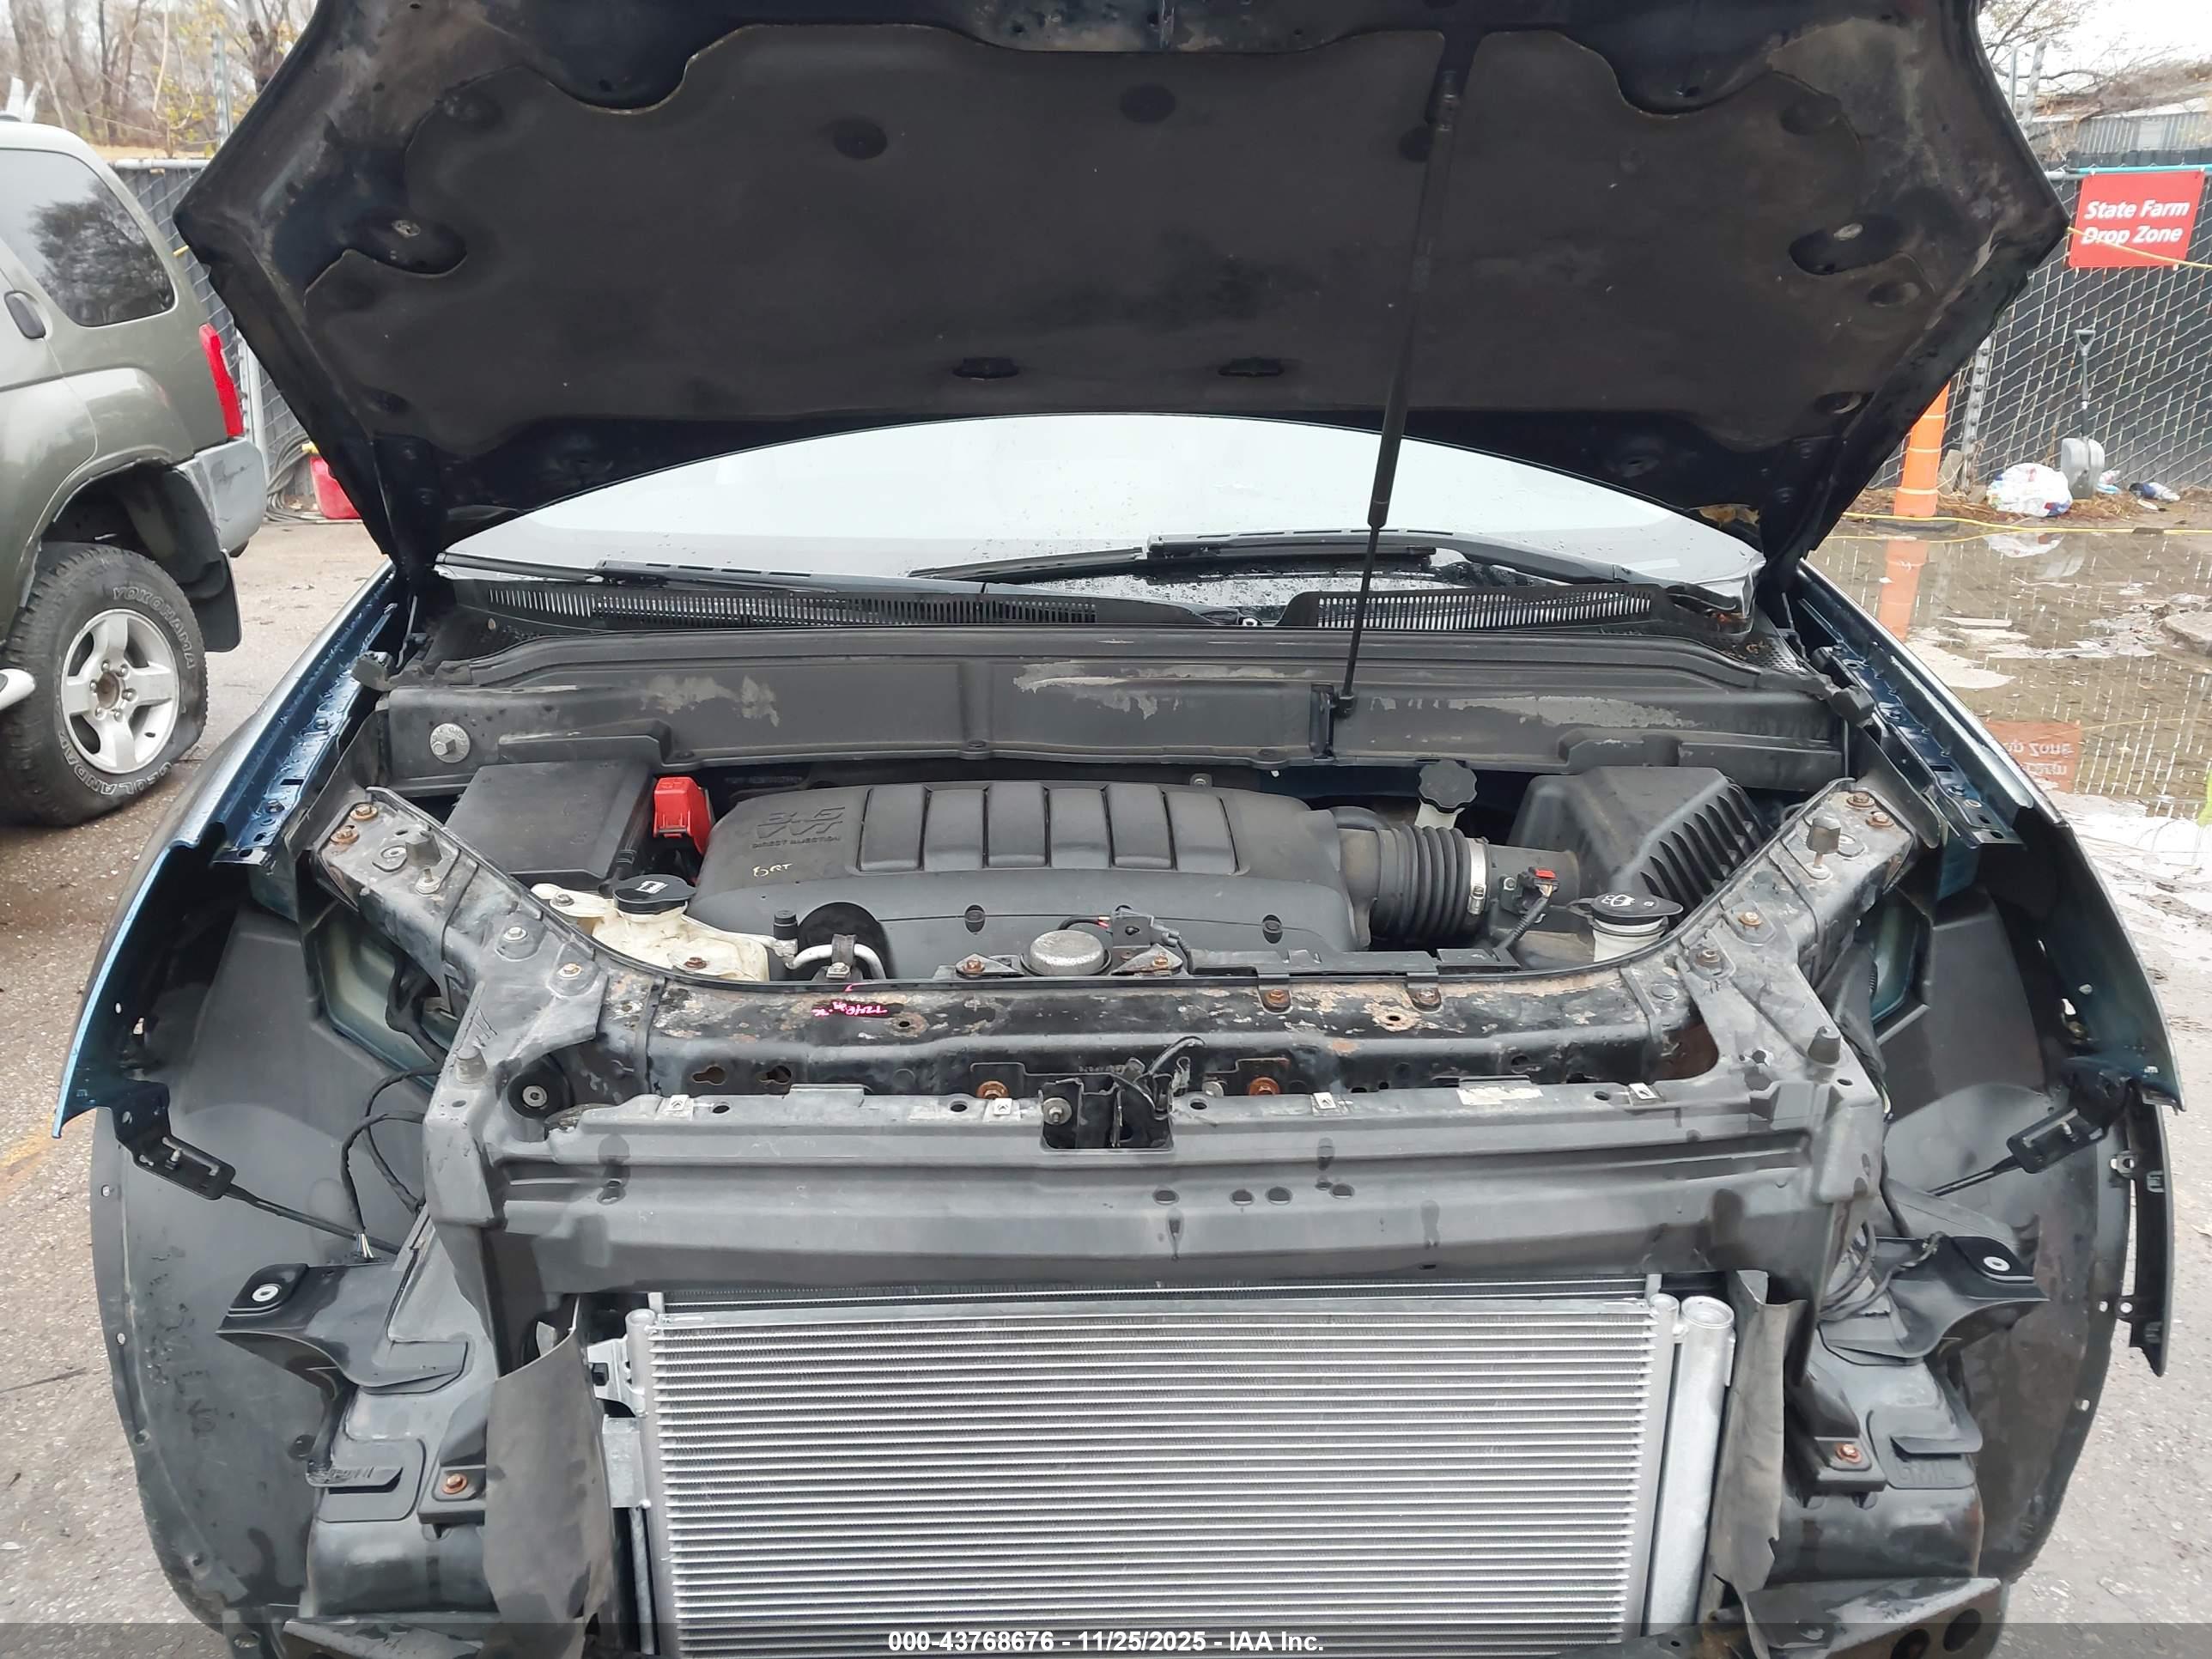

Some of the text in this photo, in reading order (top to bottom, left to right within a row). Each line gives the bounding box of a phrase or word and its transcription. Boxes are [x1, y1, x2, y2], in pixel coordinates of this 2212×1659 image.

[2084, 199, 2190, 219] State Farm
[2081, 226, 2183, 245] Drop Zone
[112, 586, 197, 670] YOKOHAMA
